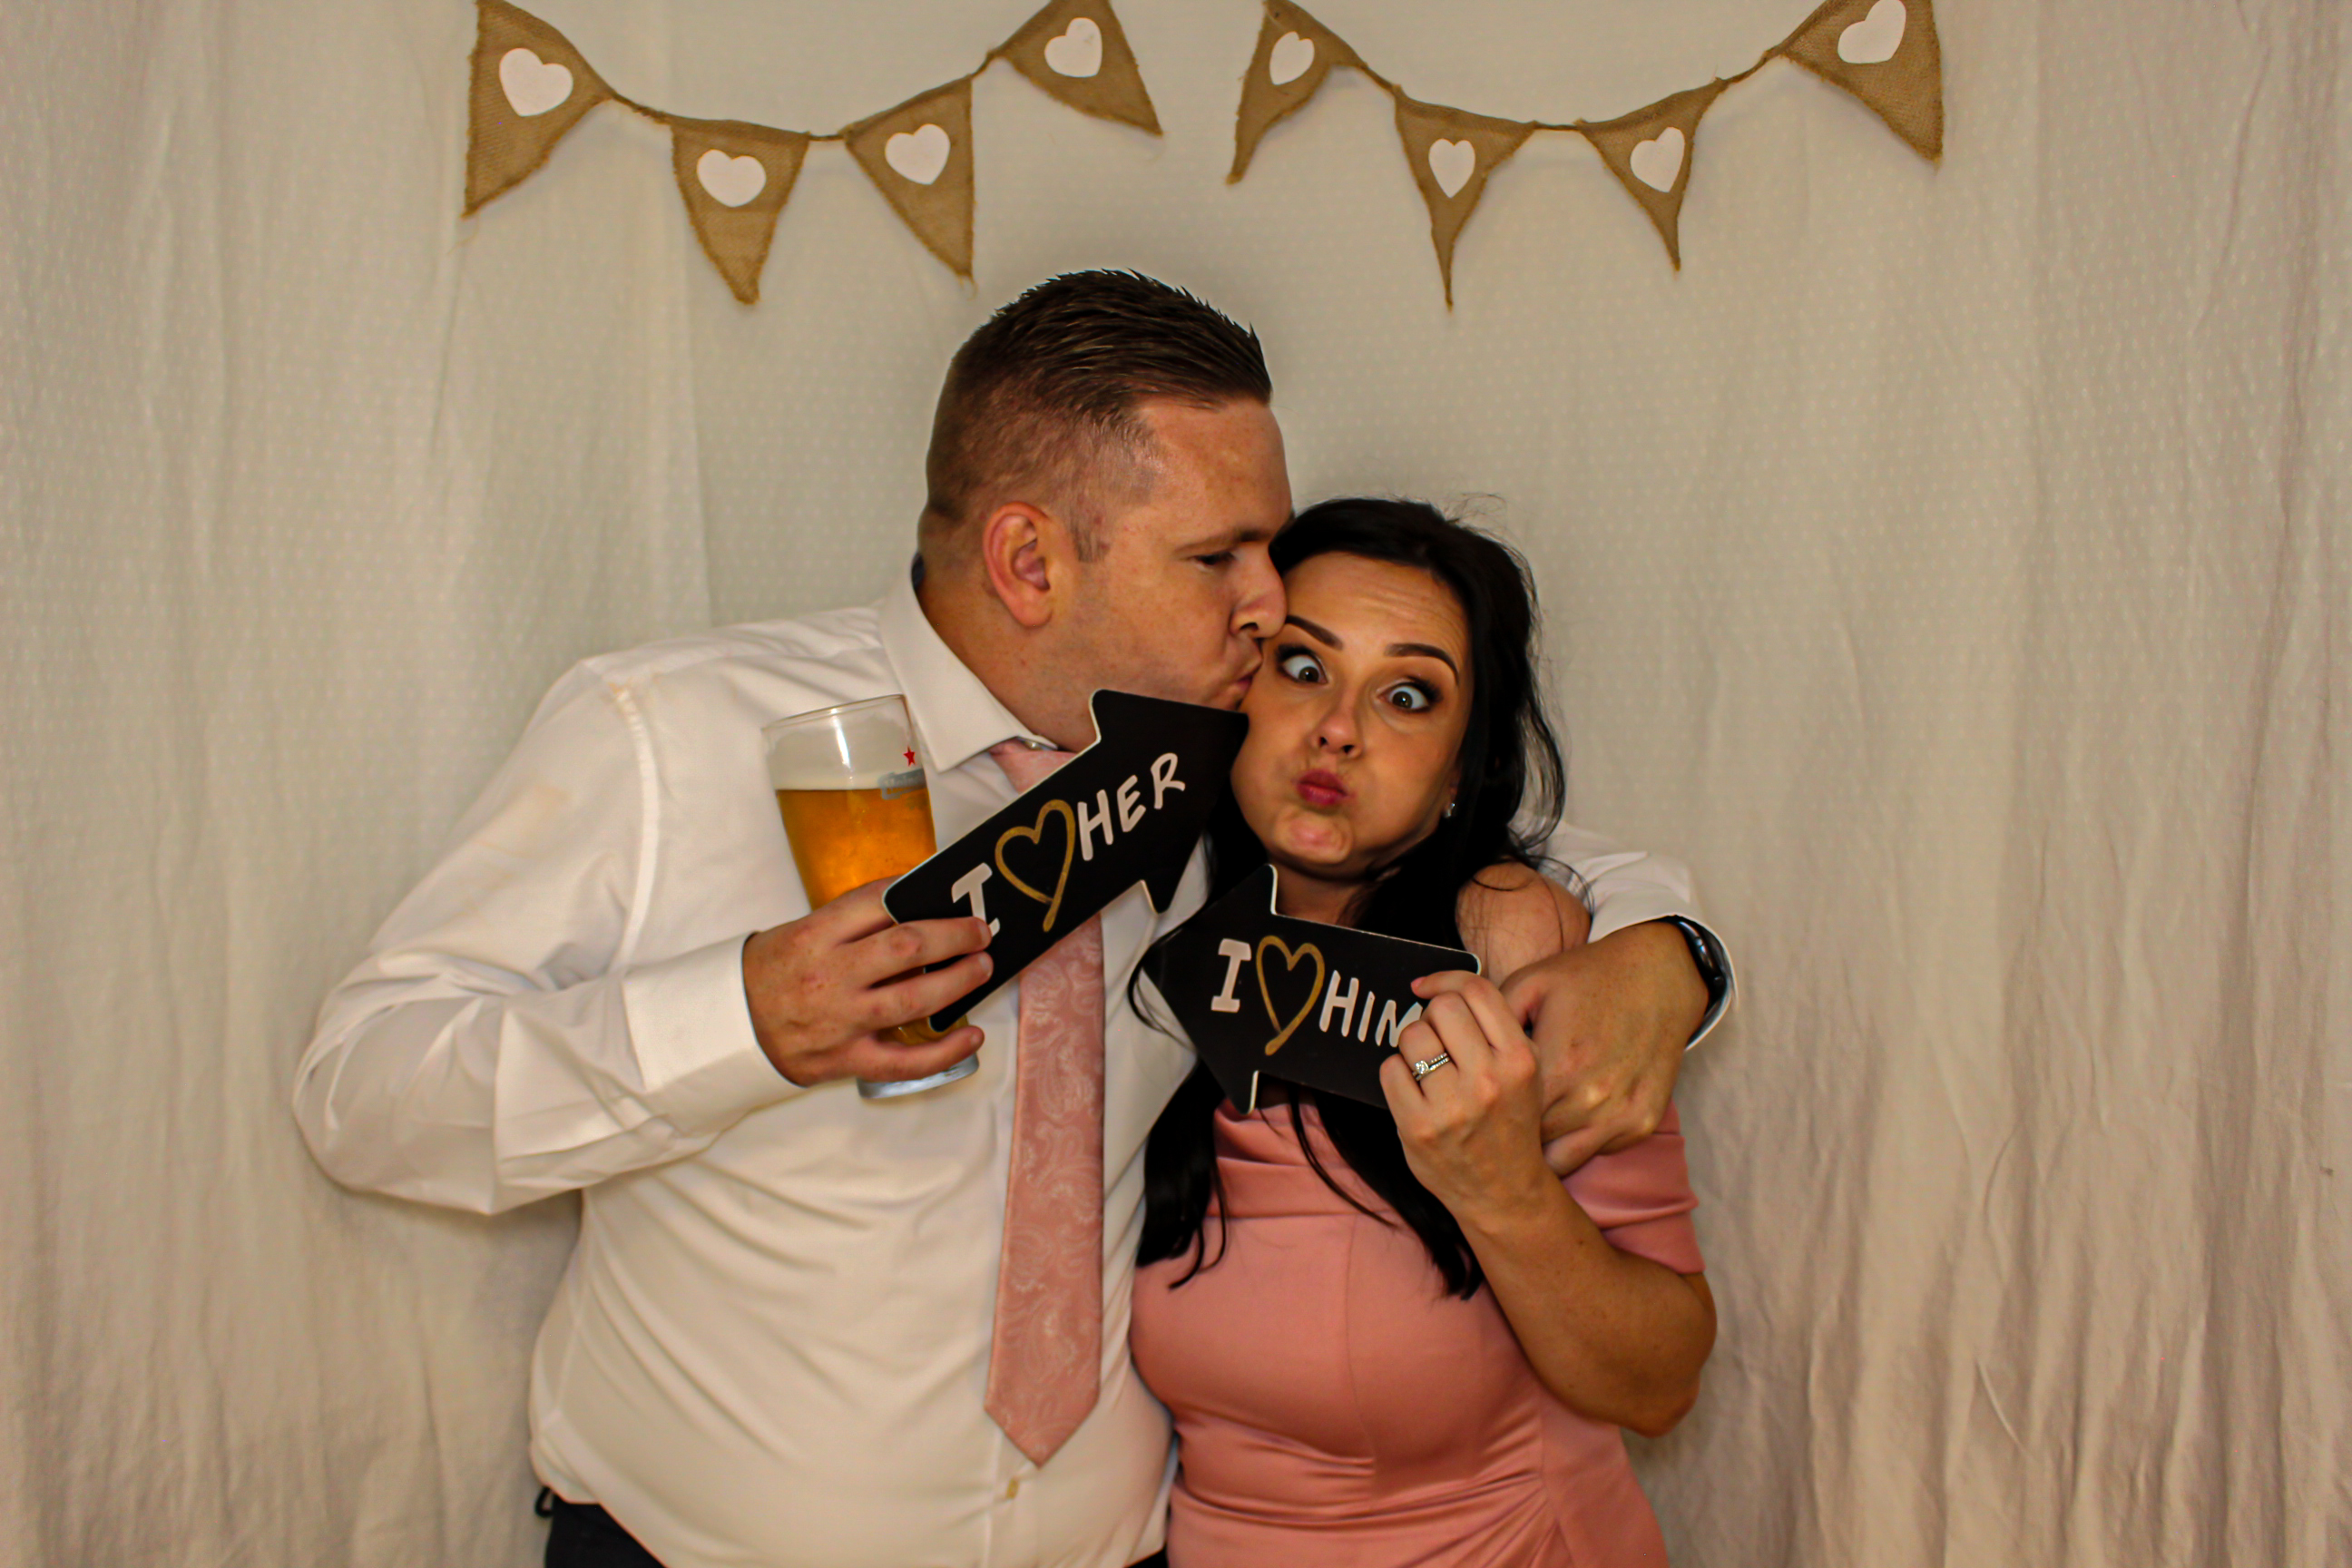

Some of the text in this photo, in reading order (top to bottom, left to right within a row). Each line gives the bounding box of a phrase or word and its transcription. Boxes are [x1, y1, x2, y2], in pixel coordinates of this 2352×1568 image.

[952, 752, 1186, 937] I HER
[1210, 937, 1252, 1014] I
